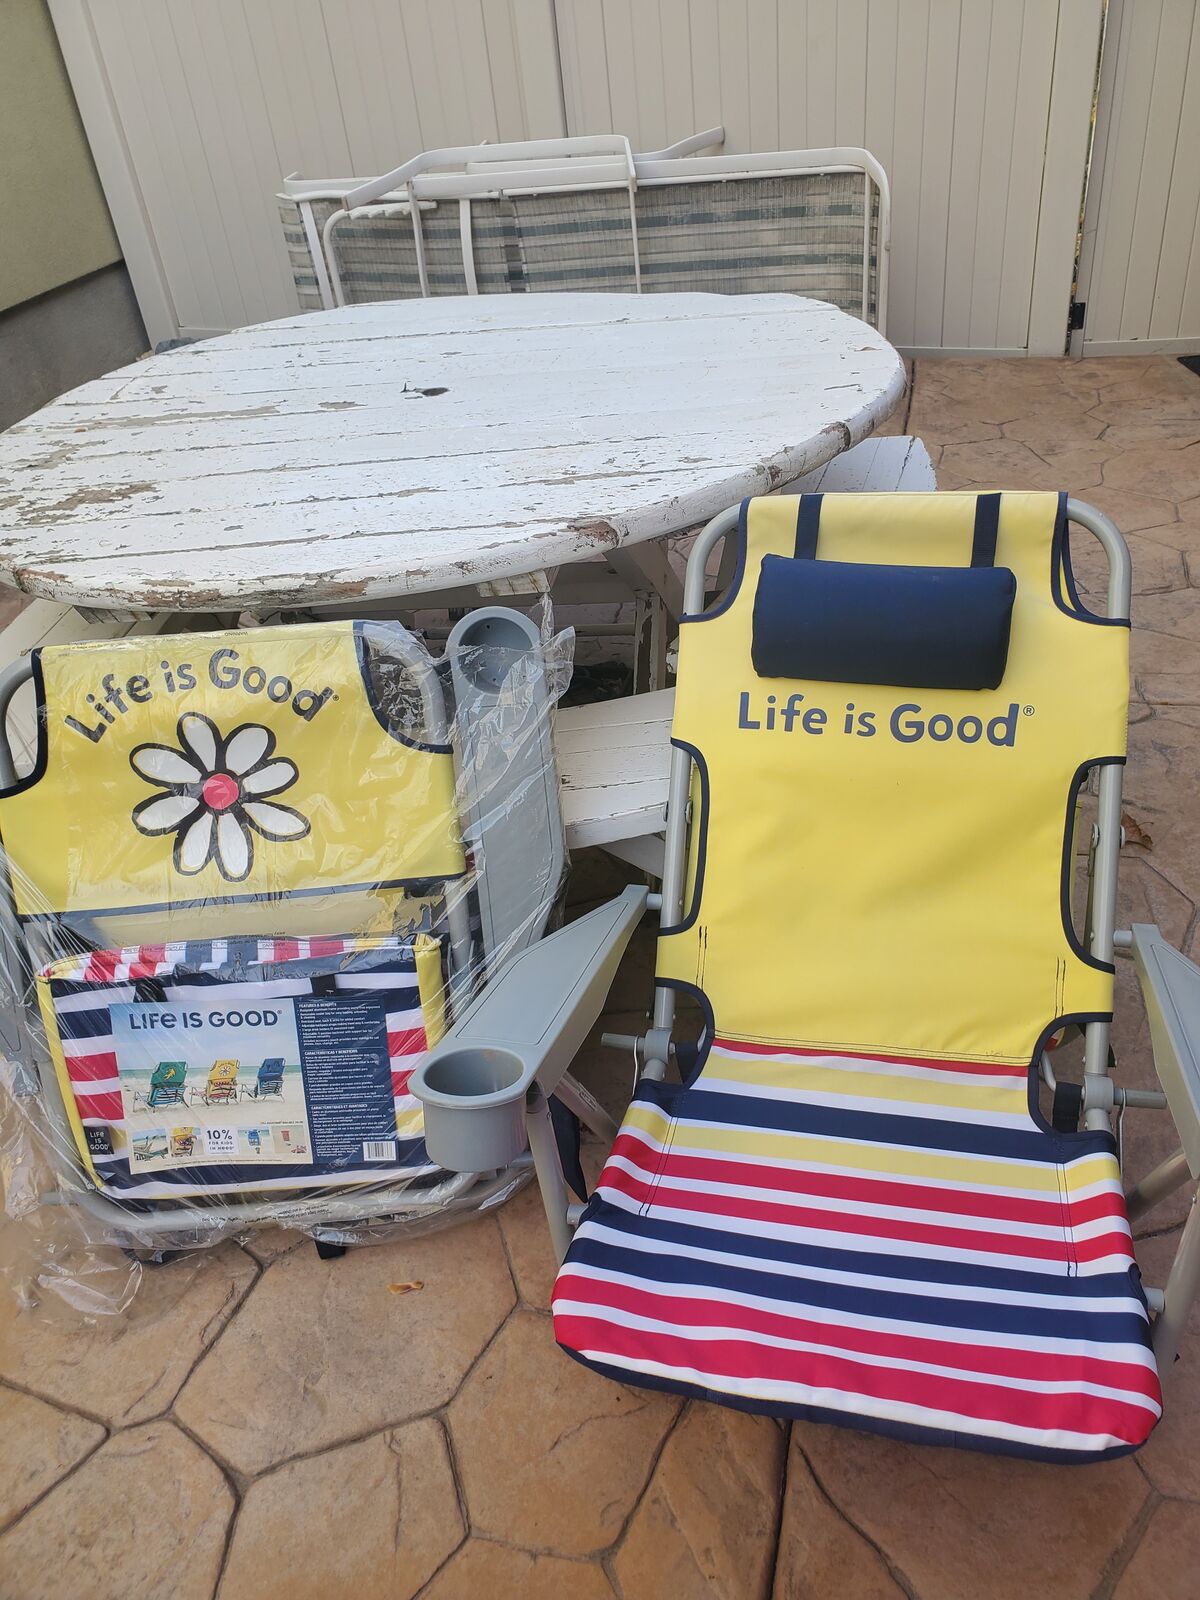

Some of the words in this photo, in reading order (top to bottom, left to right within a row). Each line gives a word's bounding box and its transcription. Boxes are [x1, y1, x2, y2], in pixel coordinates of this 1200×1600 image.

[64, 673, 153, 743] Life
[160, 660, 197, 693] is
[738, 691, 828, 735] Life
[844, 702, 877, 737] is
[183, 1011, 203, 1029] IS
[207, 1129, 233, 1140] 10%
